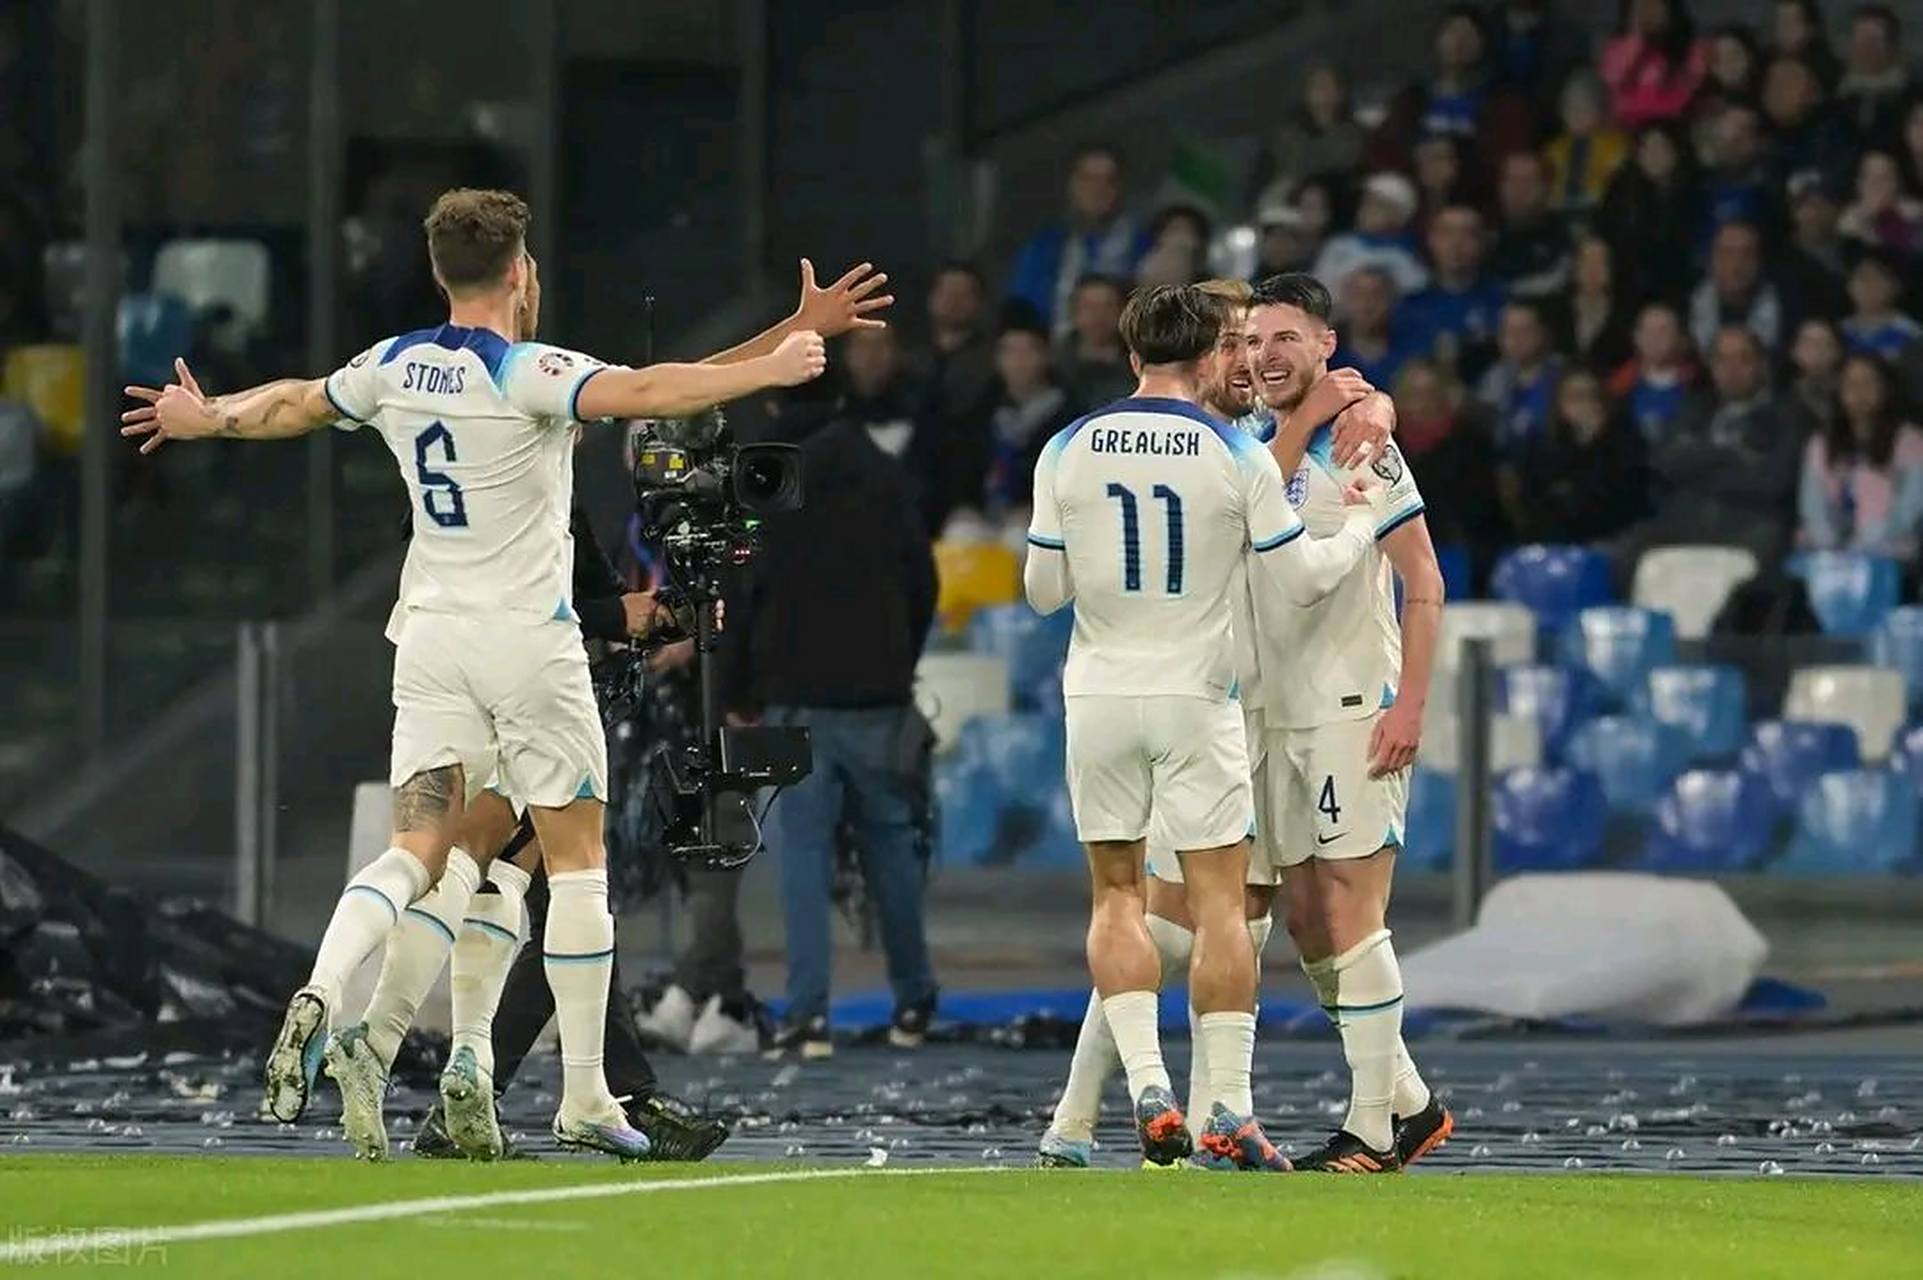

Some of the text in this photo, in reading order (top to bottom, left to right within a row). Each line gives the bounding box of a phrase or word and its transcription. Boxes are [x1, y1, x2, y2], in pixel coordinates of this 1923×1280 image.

[415, 420, 469, 527] 6
[1107, 483, 1183, 593] 11
[1318, 774, 1341, 823] 4
